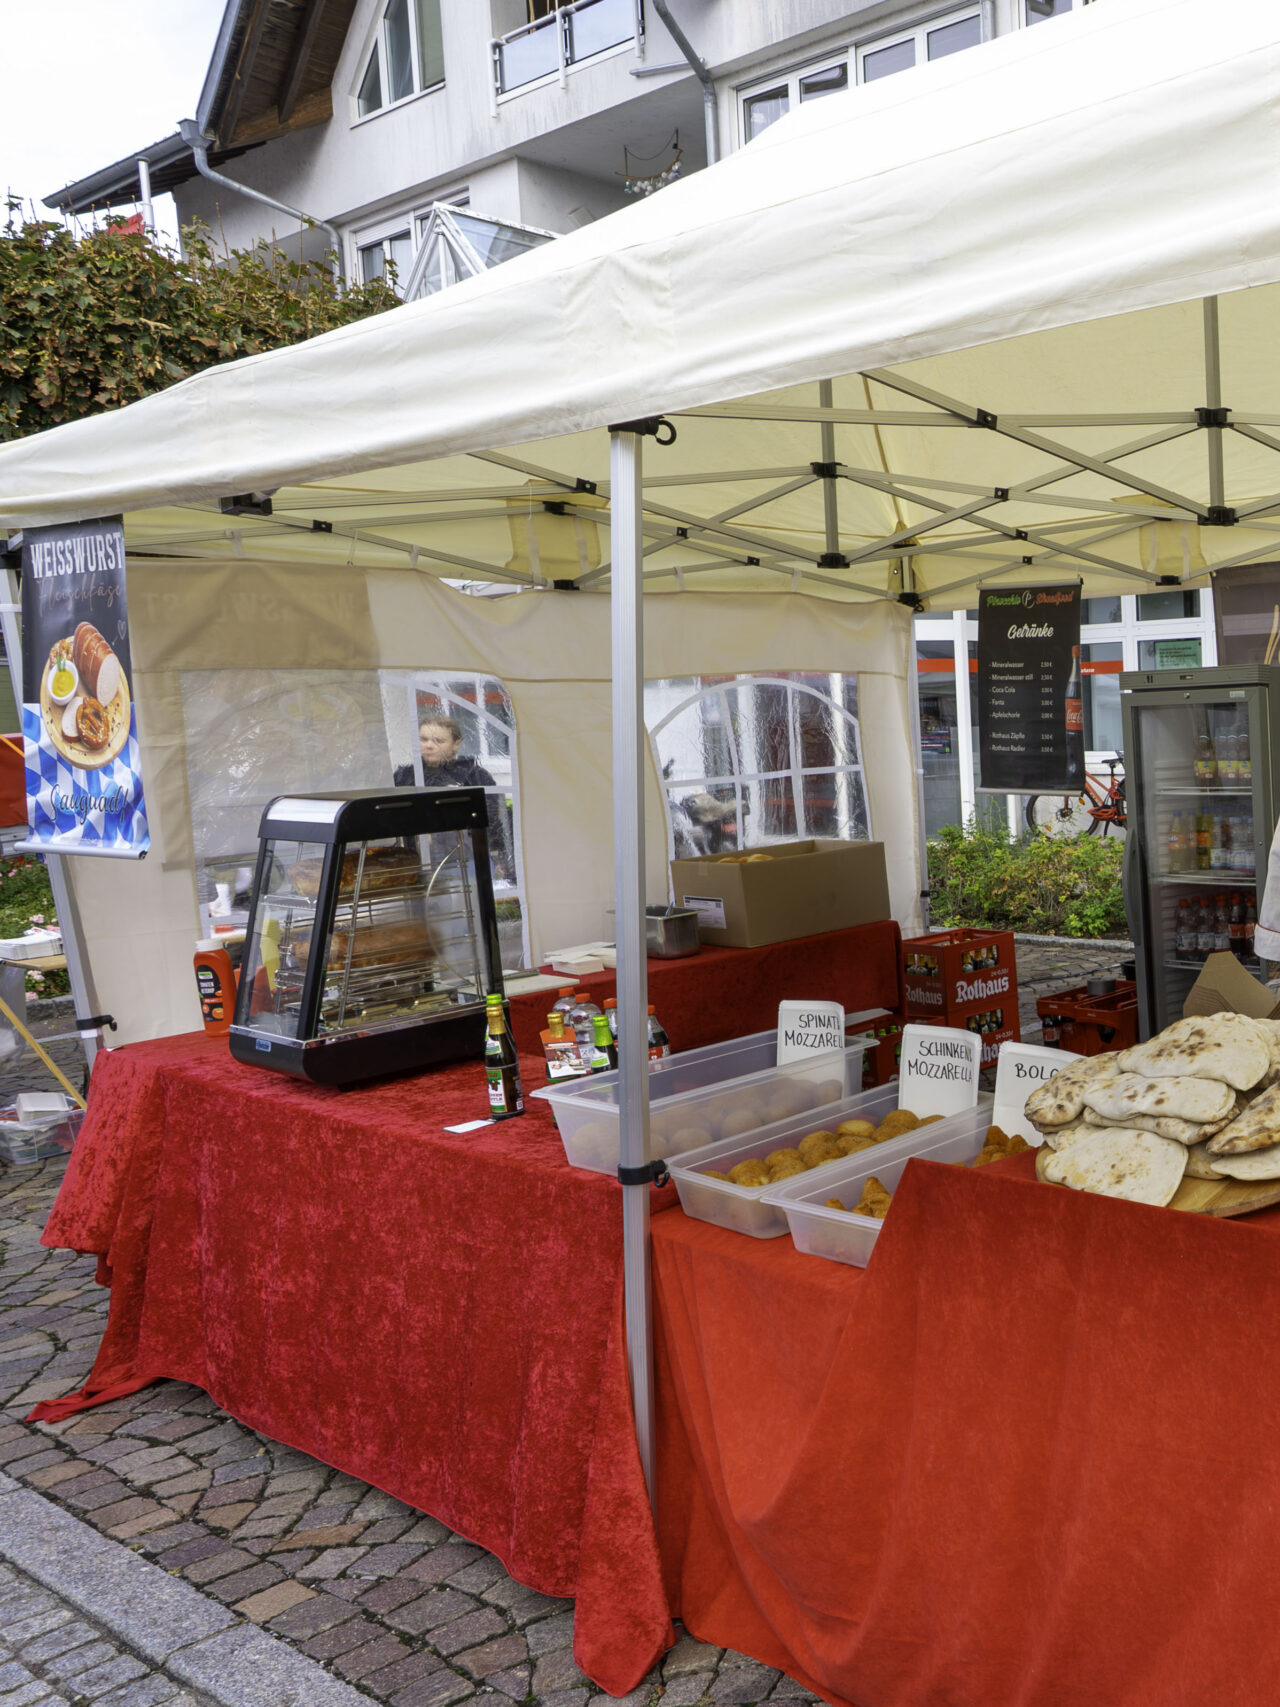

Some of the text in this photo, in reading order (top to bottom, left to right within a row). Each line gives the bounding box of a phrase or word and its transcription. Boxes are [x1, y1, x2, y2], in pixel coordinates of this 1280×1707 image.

[30, 532, 122, 578] WEISSWURST
[1007, 622, 1054, 640] Getränke
[50, 784, 129, 825] Sauguad!
[906, 984, 942, 1006] Rothaus
[955, 976, 1010, 1003] Rothaus
